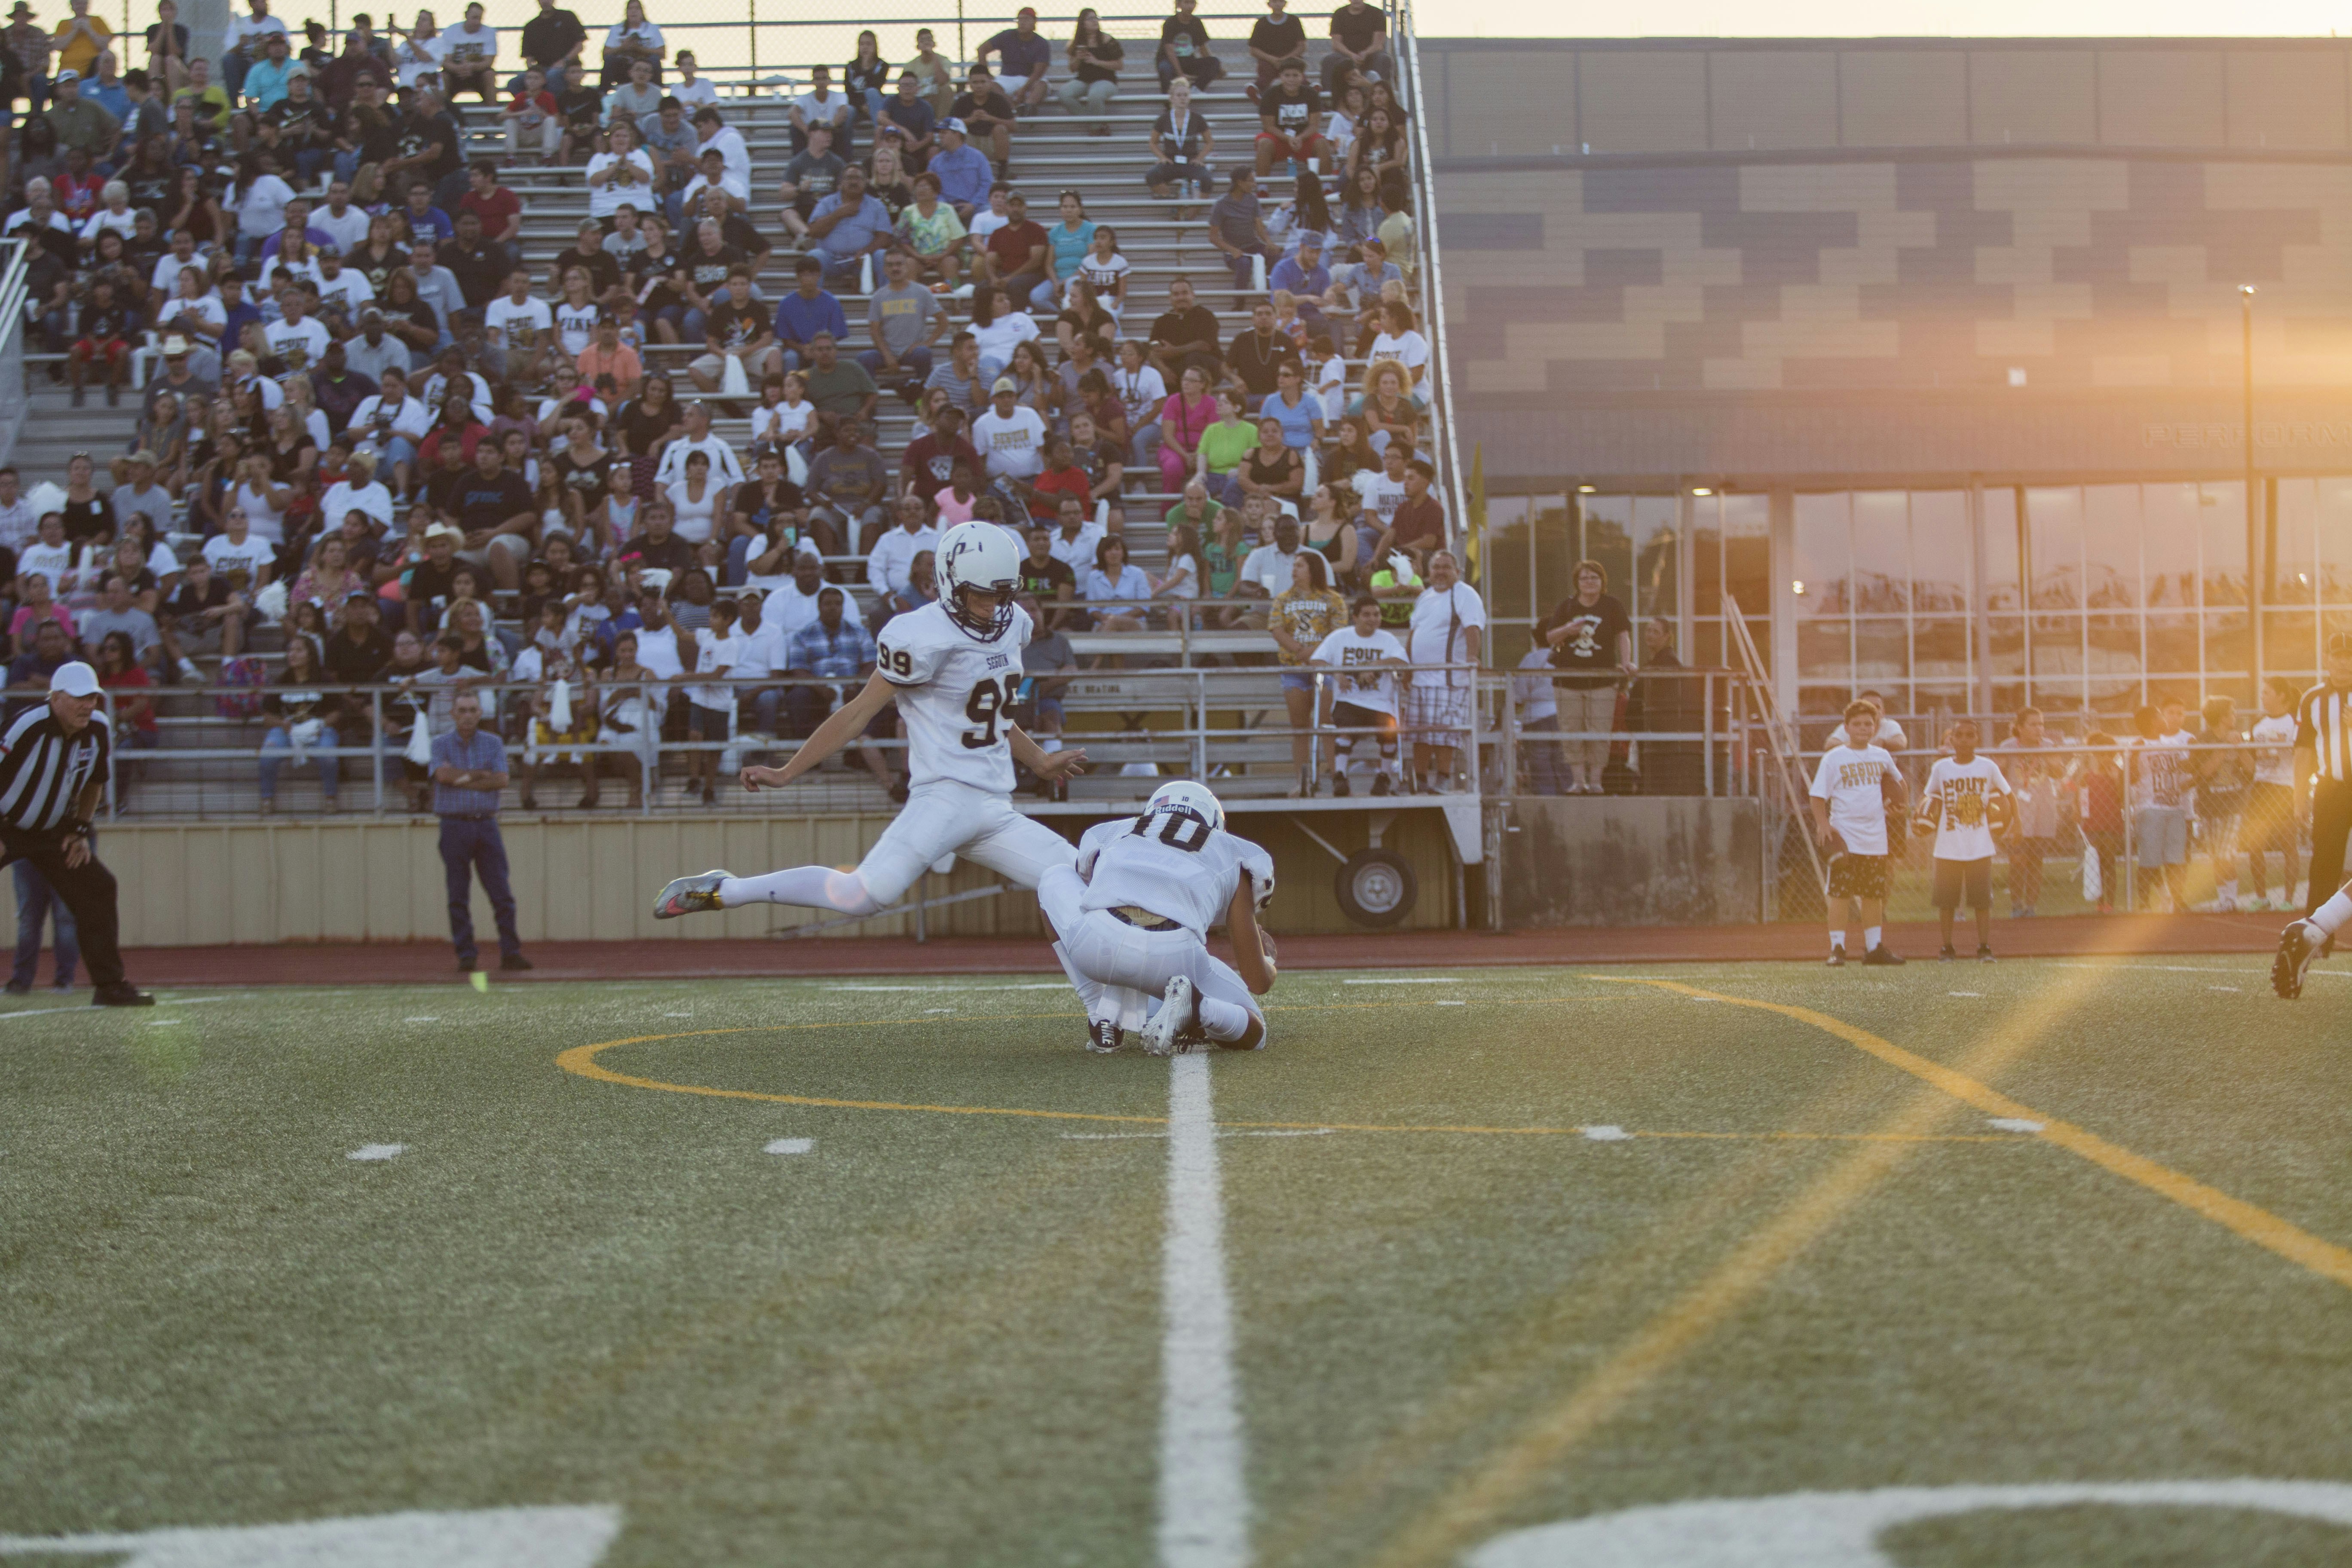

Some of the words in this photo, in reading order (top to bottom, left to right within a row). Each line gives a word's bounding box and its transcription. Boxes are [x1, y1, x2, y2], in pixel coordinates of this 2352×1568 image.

[879, 643, 911, 676] 99
[986, 653, 1009, 670] SEGUIN
[1955, 777, 1987, 792] OUT
[1155, 804, 1192, 815] Riddell
[1120, 813, 1215, 853] 10
[1100, 1020, 1115, 1046] NIKE
